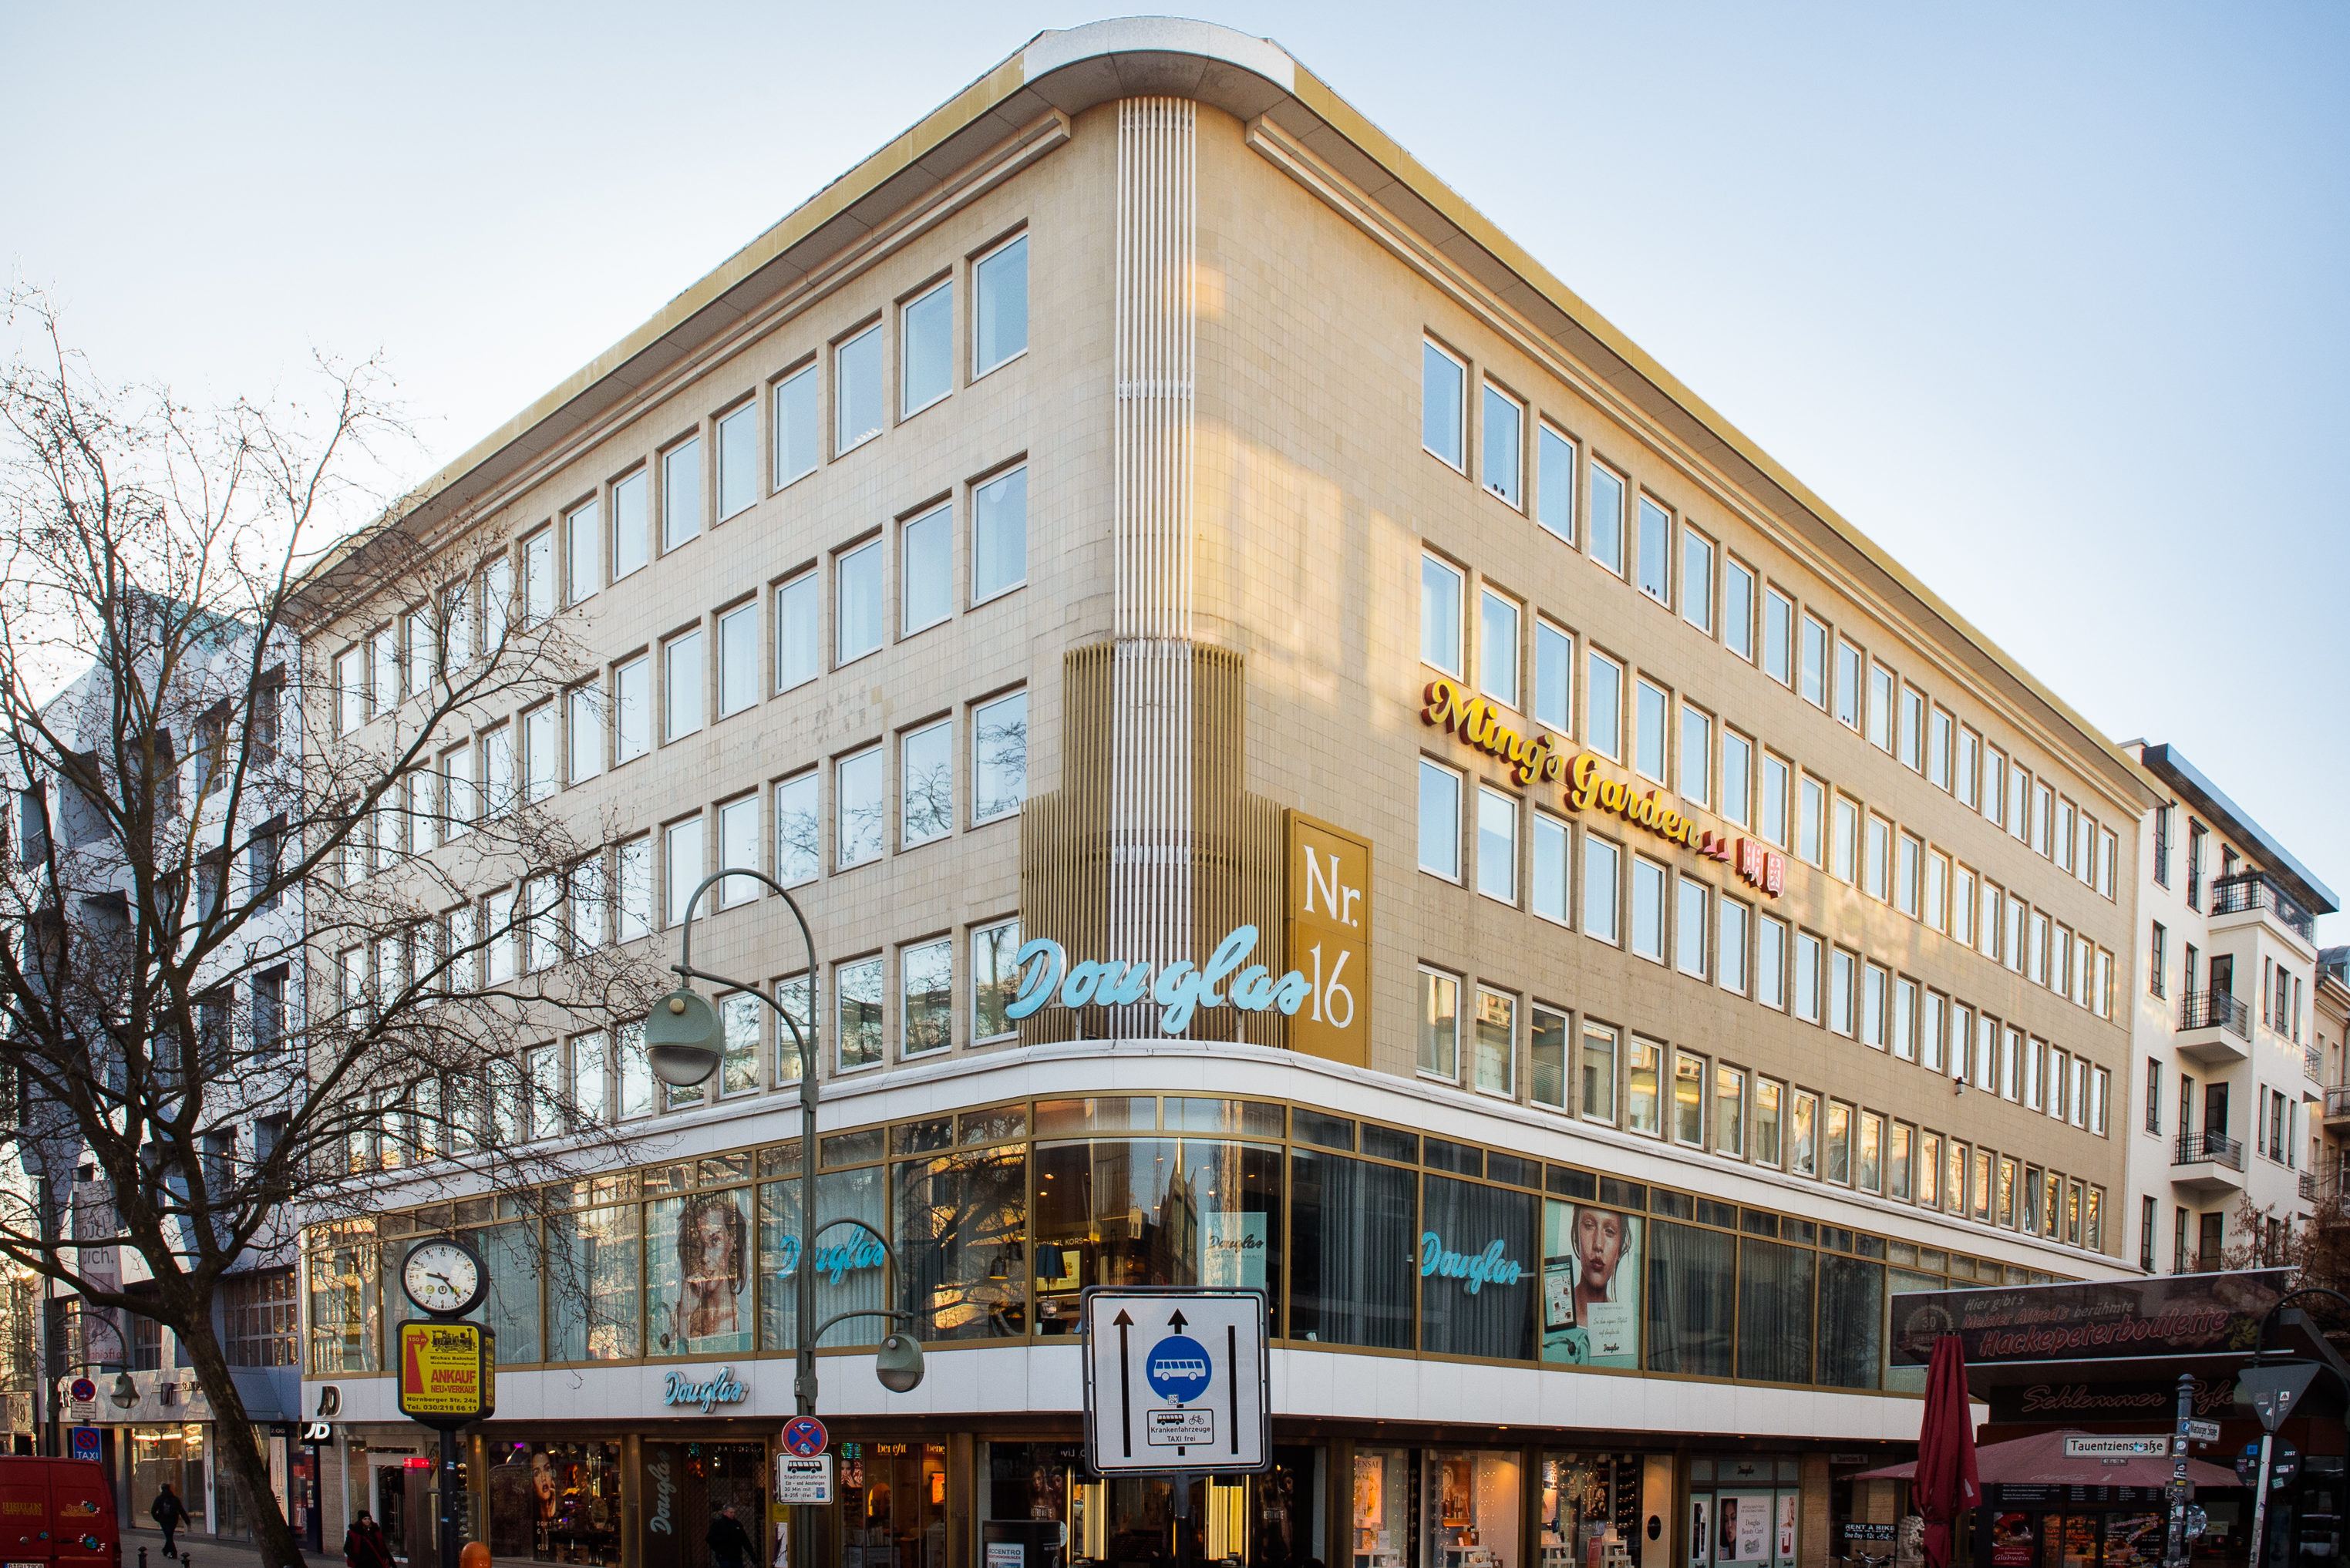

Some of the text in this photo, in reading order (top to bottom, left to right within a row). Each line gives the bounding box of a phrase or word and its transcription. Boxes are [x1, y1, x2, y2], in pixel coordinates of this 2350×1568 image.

[1421, 678, 1700, 849] Ming's Garden
[1303, 844, 1362, 928] Nr.
[1005, 925, 1312, 1035] Douglas
[1309, 940, 1355, 1029] 16
[776, 1226, 885, 1285] Duglas
[1065, 1237, 1083, 1246] KORS
[1209, 1233, 1264, 1253] Douglas
[1420, 1231, 1522, 1294] Douglas
[1961, 1313, 2012, 1330] Meister
[2073, 1300, 2135, 1318] berühmte
[1965, 1298, 1989, 1311] Hier
[1921, 1316, 1937, 1328] 30
[1979, 1306, 2229, 1357] Hackepeterboulette
[431, 1369, 476, 1384] ANKAUF
[664, 1365, 749, 1413] Douglas
[2022, 1380, 2234, 1415] Schlemmer Pylo
[305, 1422, 331, 1439] JD
[76, 1451, 99, 1459] TAXI
[926, 1443, 945, 1455] bene
[2071, 1440, 2163, 1453] Tauentzienstaße
[1353, 1460, 1379, 1469] SENSAI
[648, 1450, 677, 1536] Douglas
